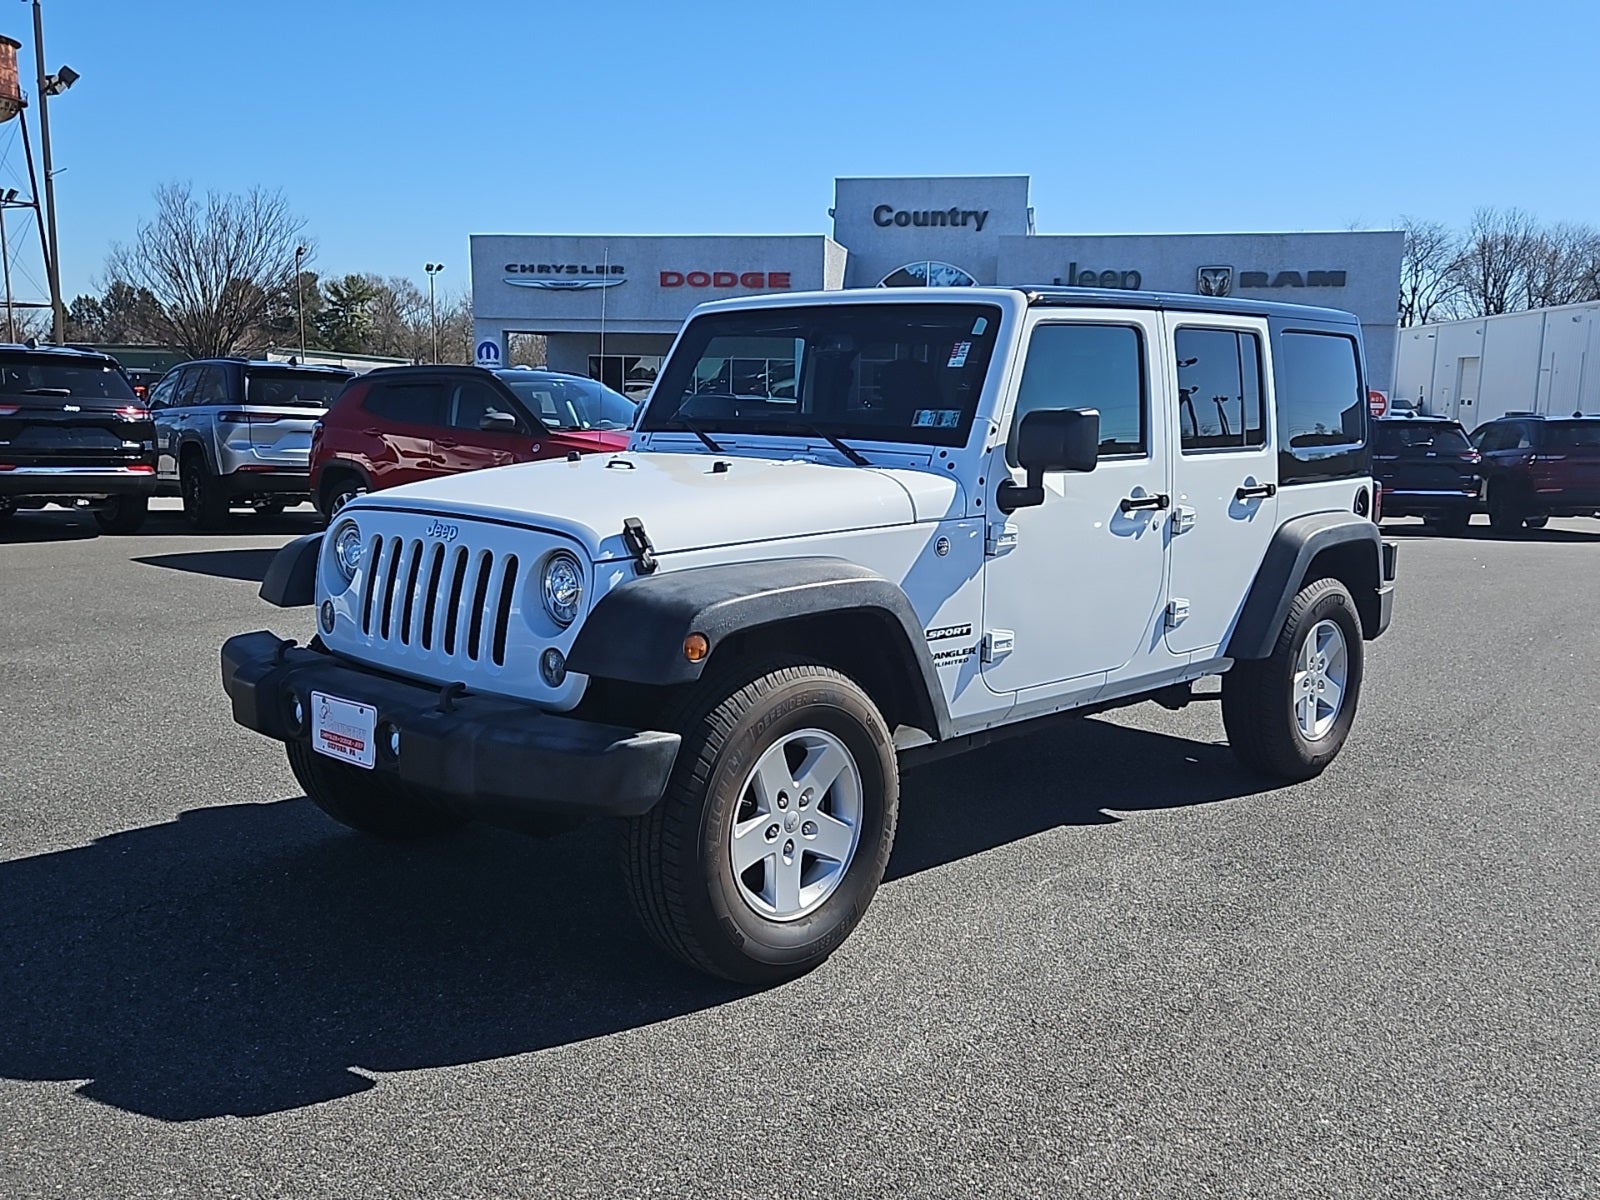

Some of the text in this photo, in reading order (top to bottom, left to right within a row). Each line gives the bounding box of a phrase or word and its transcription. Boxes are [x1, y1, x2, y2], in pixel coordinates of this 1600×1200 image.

[873, 204, 989, 231] Country
[504, 264, 625, 274] CHRYSLER
[1053, 262, 1142, 290] Jeep
[660, 271, 791, 289] DODGE
[1239, 270, 1346, 288] RAM
[425, 519, 459, 542] Jeep
[928, 626, 969, 639] SPORT
[932, 646, 976, 660] ANGLER
[934, 657, 969, 668] LIMITED
